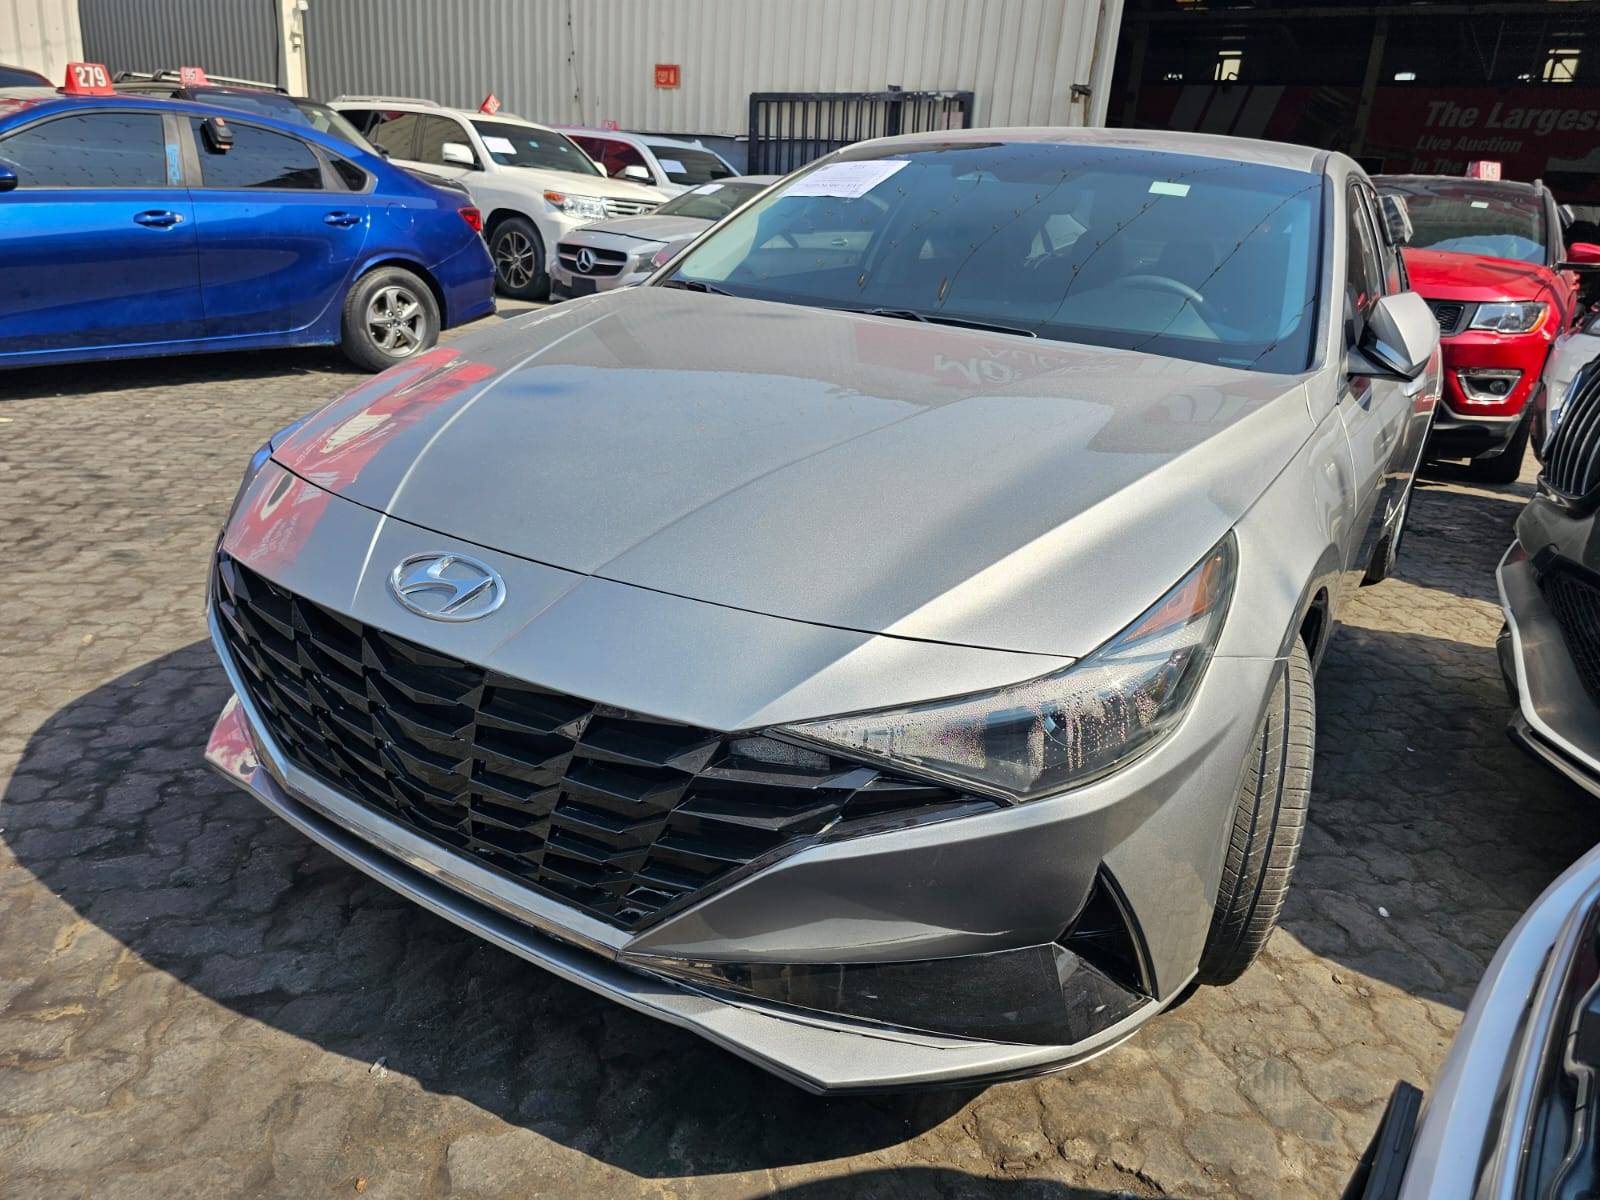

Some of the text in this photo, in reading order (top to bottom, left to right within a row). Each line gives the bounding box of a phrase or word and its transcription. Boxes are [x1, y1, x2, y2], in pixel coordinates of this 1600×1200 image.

[75, 66, 107, 88] 279
[1424, 100, 1600, 137] The Larges
[1416, 135, 1524, 153] Live Auction
[1433, 158, 1463, 174] The
